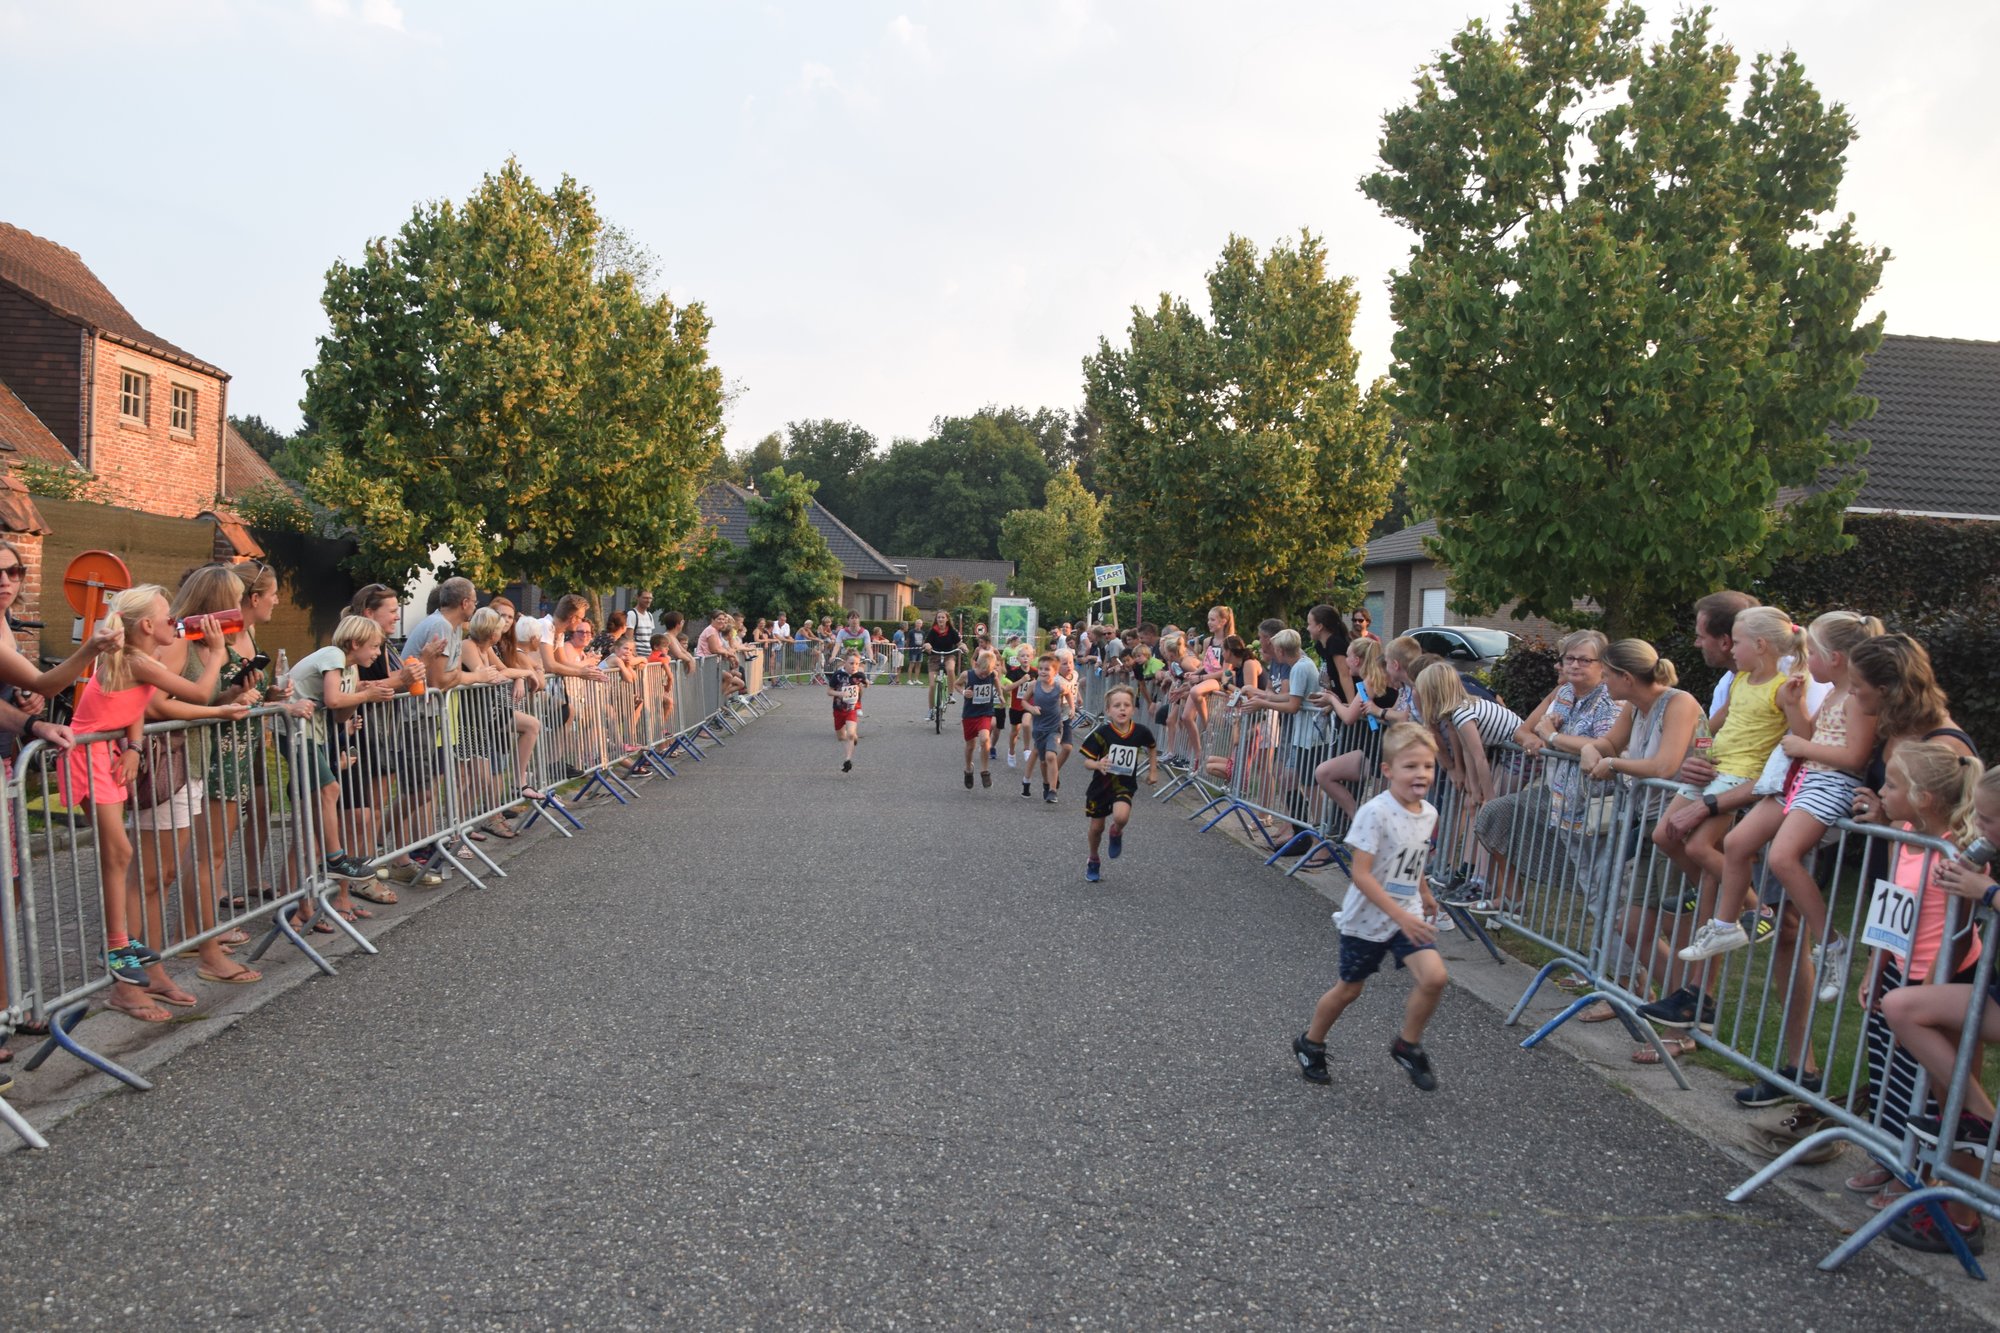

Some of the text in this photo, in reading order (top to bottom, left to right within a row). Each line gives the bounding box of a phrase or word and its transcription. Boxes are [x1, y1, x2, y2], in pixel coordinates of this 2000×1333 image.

[1097, 569, 1123, 582] START
[975, 685, 990, 697] 143
[1111, 747, 1134, 767] 130
[1878, 888, 1914, 935] 170
